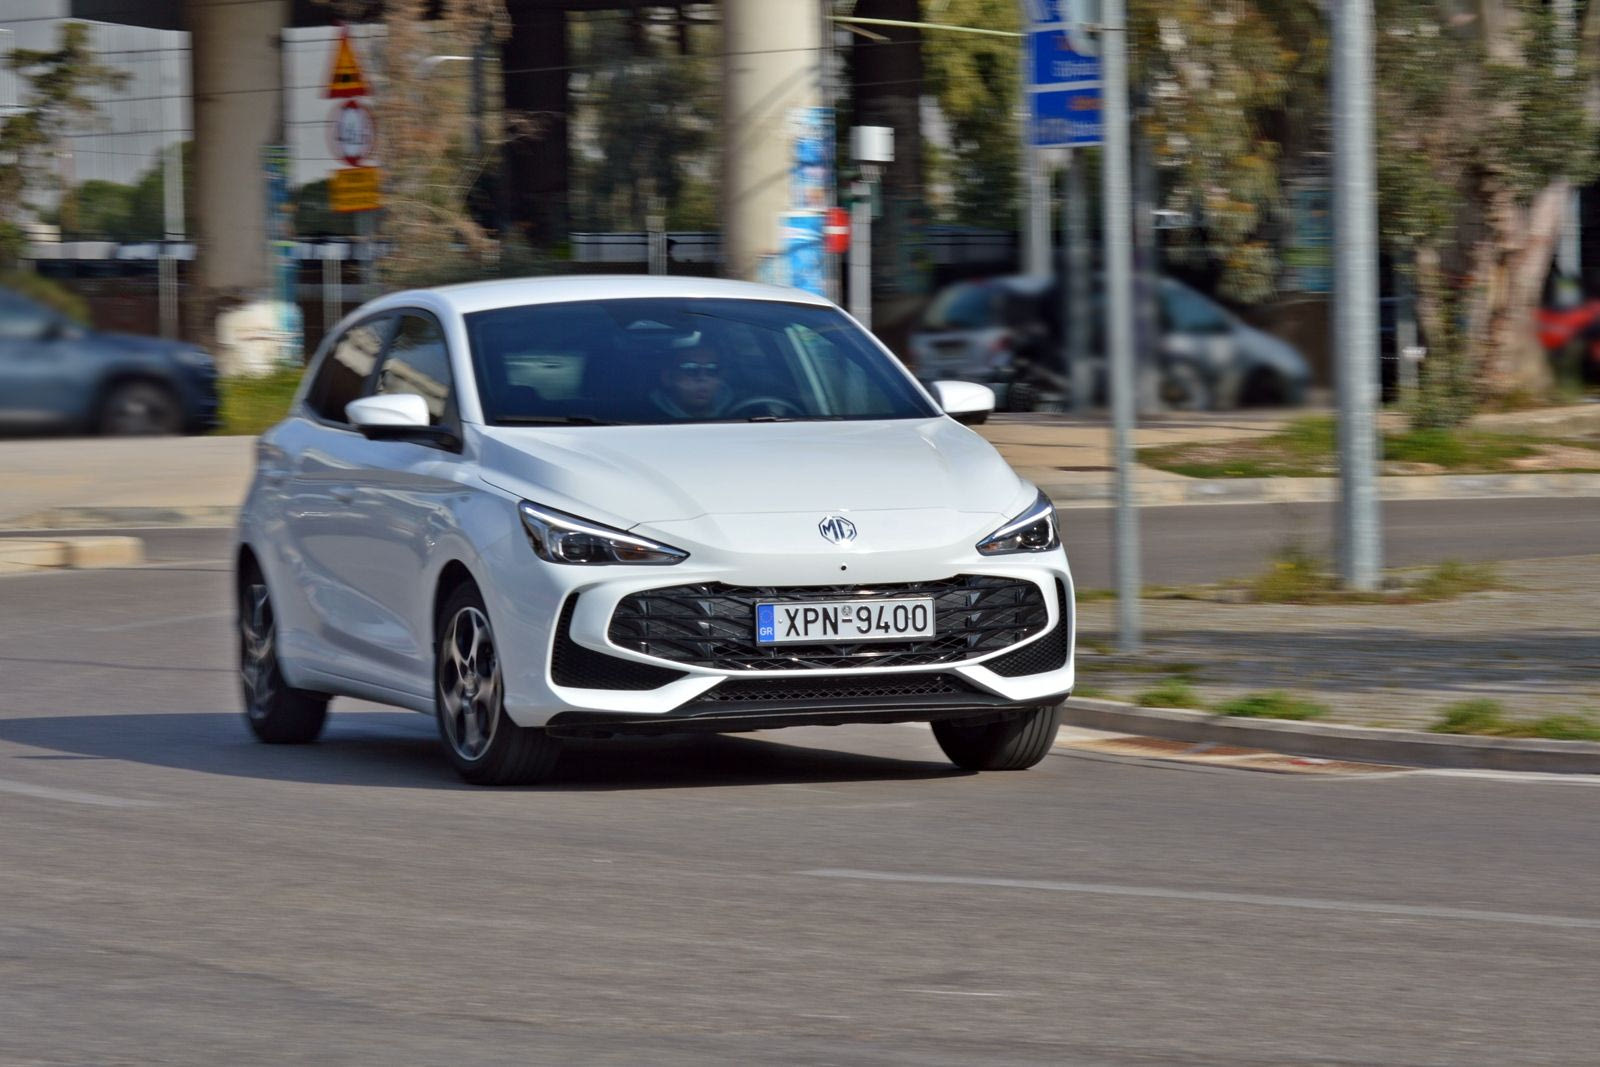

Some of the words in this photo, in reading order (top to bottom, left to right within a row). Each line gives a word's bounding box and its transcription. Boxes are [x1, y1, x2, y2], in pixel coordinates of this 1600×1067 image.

[820, 517, 855, 543] MG
[760, 627, 773, 636] GR
[784, 604, 928, 637] XPN-9400
